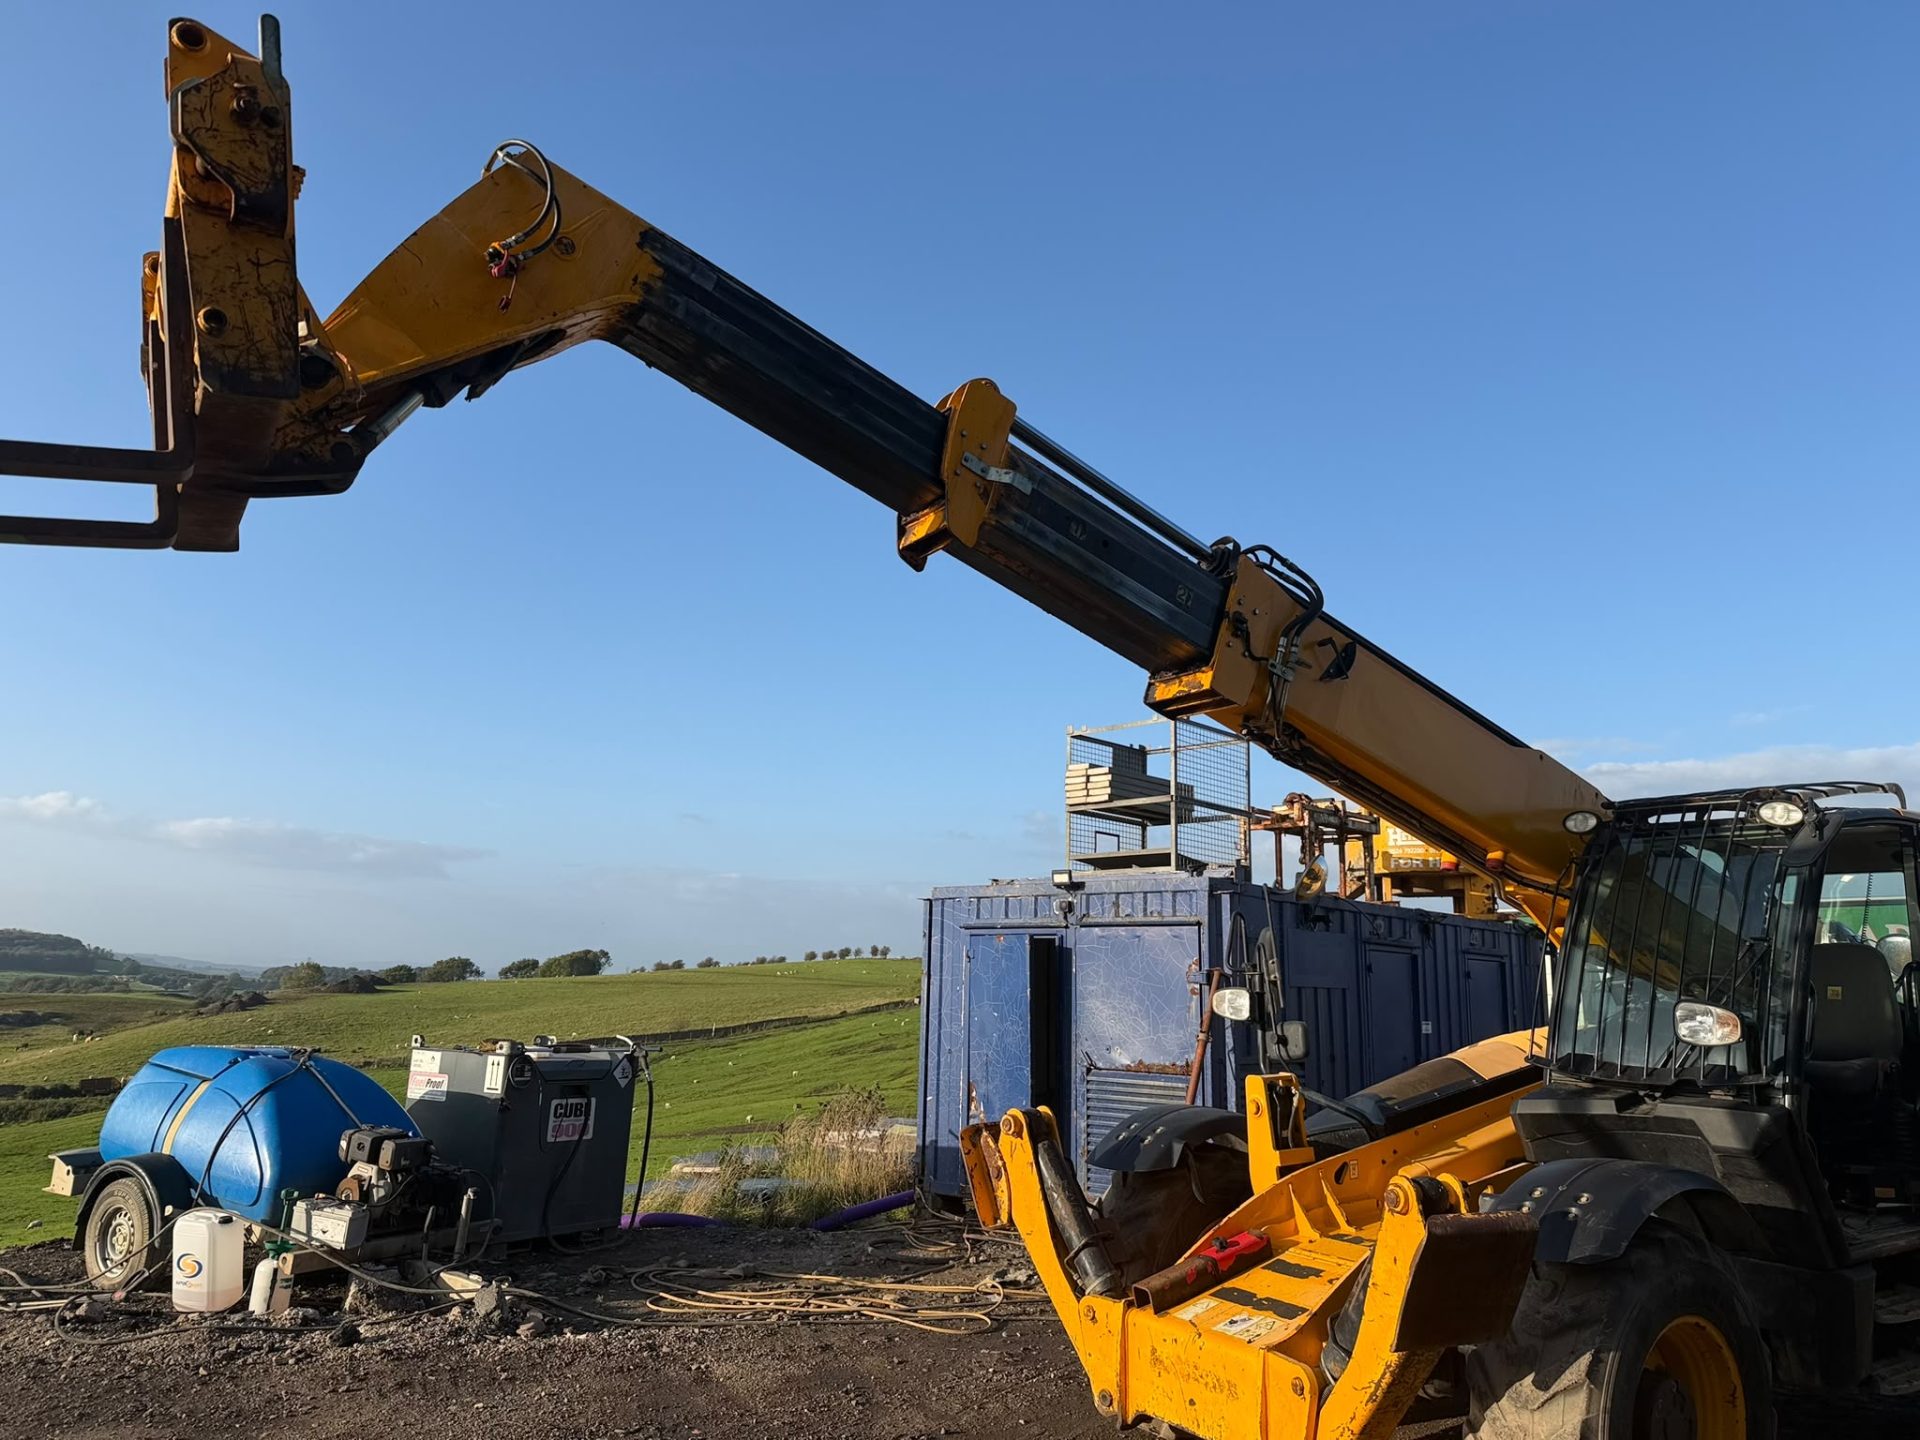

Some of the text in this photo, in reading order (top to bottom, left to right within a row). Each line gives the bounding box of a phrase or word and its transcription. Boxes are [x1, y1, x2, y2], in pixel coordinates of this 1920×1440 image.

[1391, 857, 1424, 868] FOR
[553, 1102, 591, 1119] CUB
[551, 1123, 590, 1138] 900
